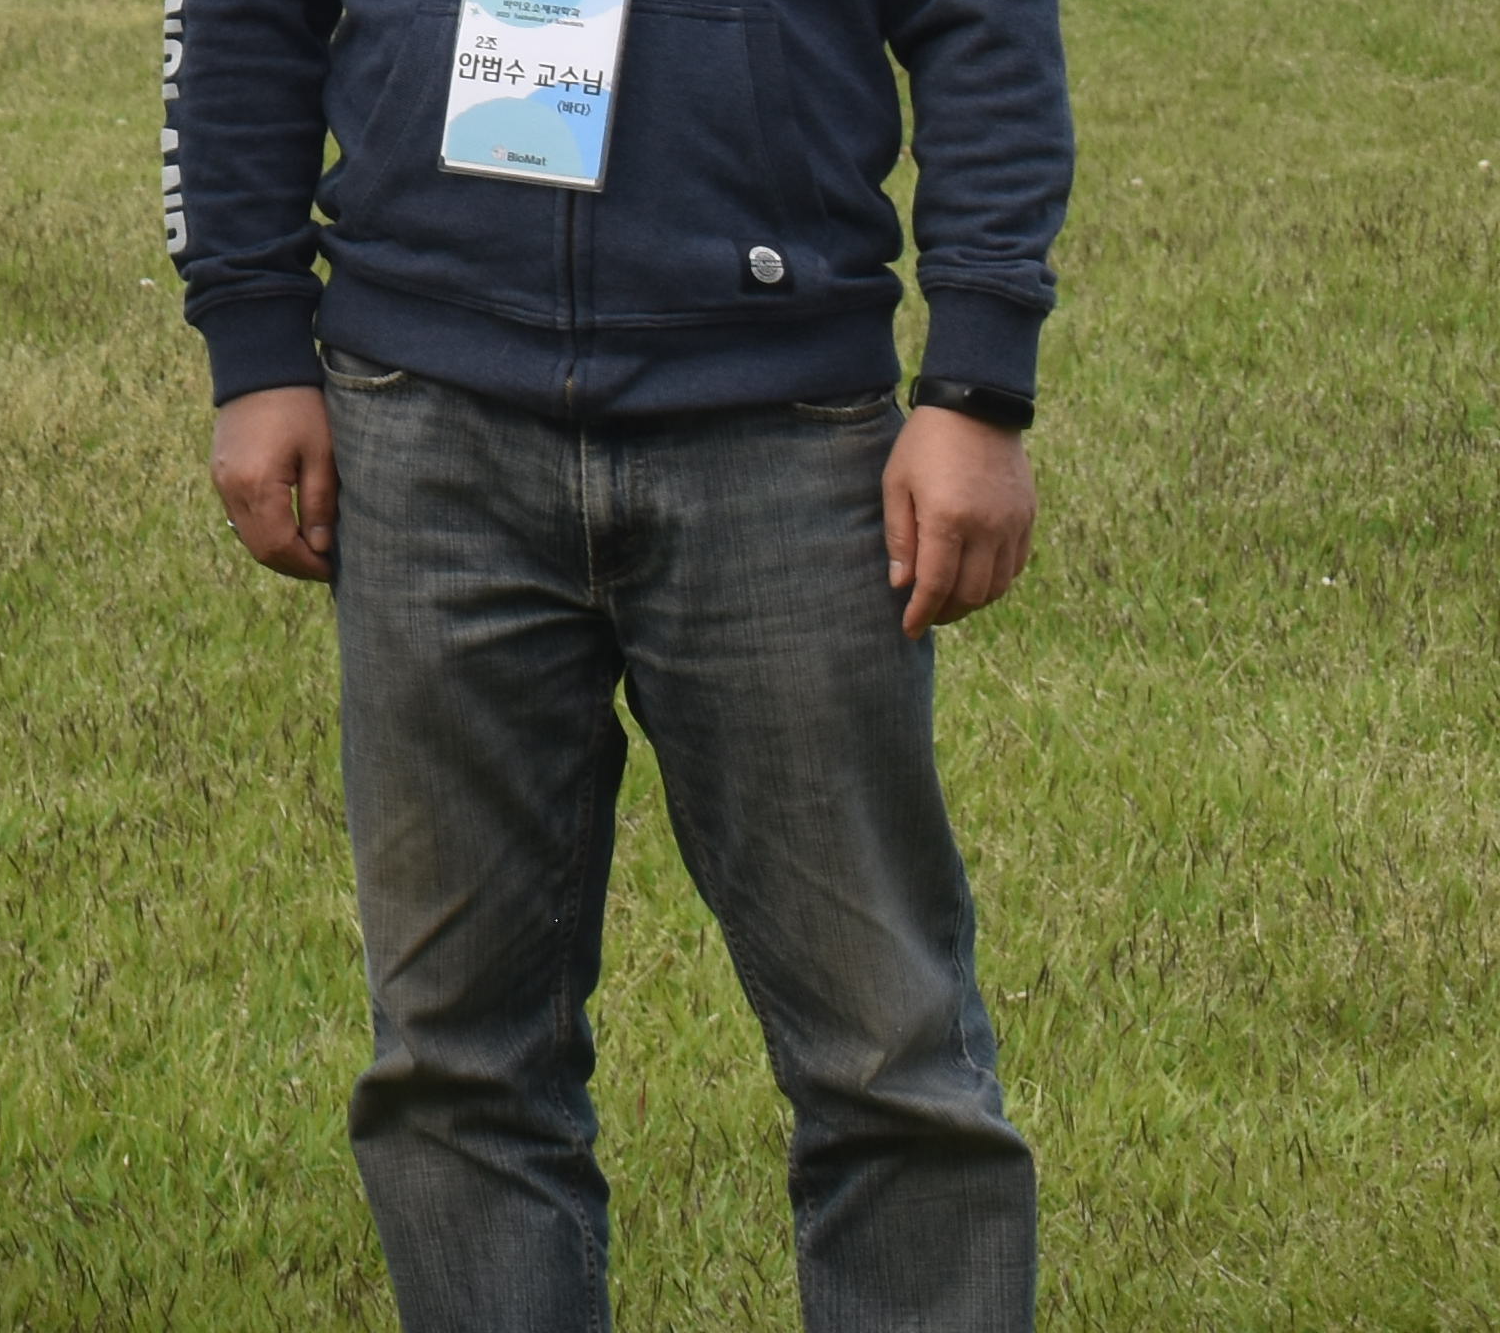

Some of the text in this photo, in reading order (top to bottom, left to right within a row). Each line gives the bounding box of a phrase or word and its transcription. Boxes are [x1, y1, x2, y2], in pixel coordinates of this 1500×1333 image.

[475, 35, 498, 50] 2조
[458, 52, 604, 96] 안범수 교수님
